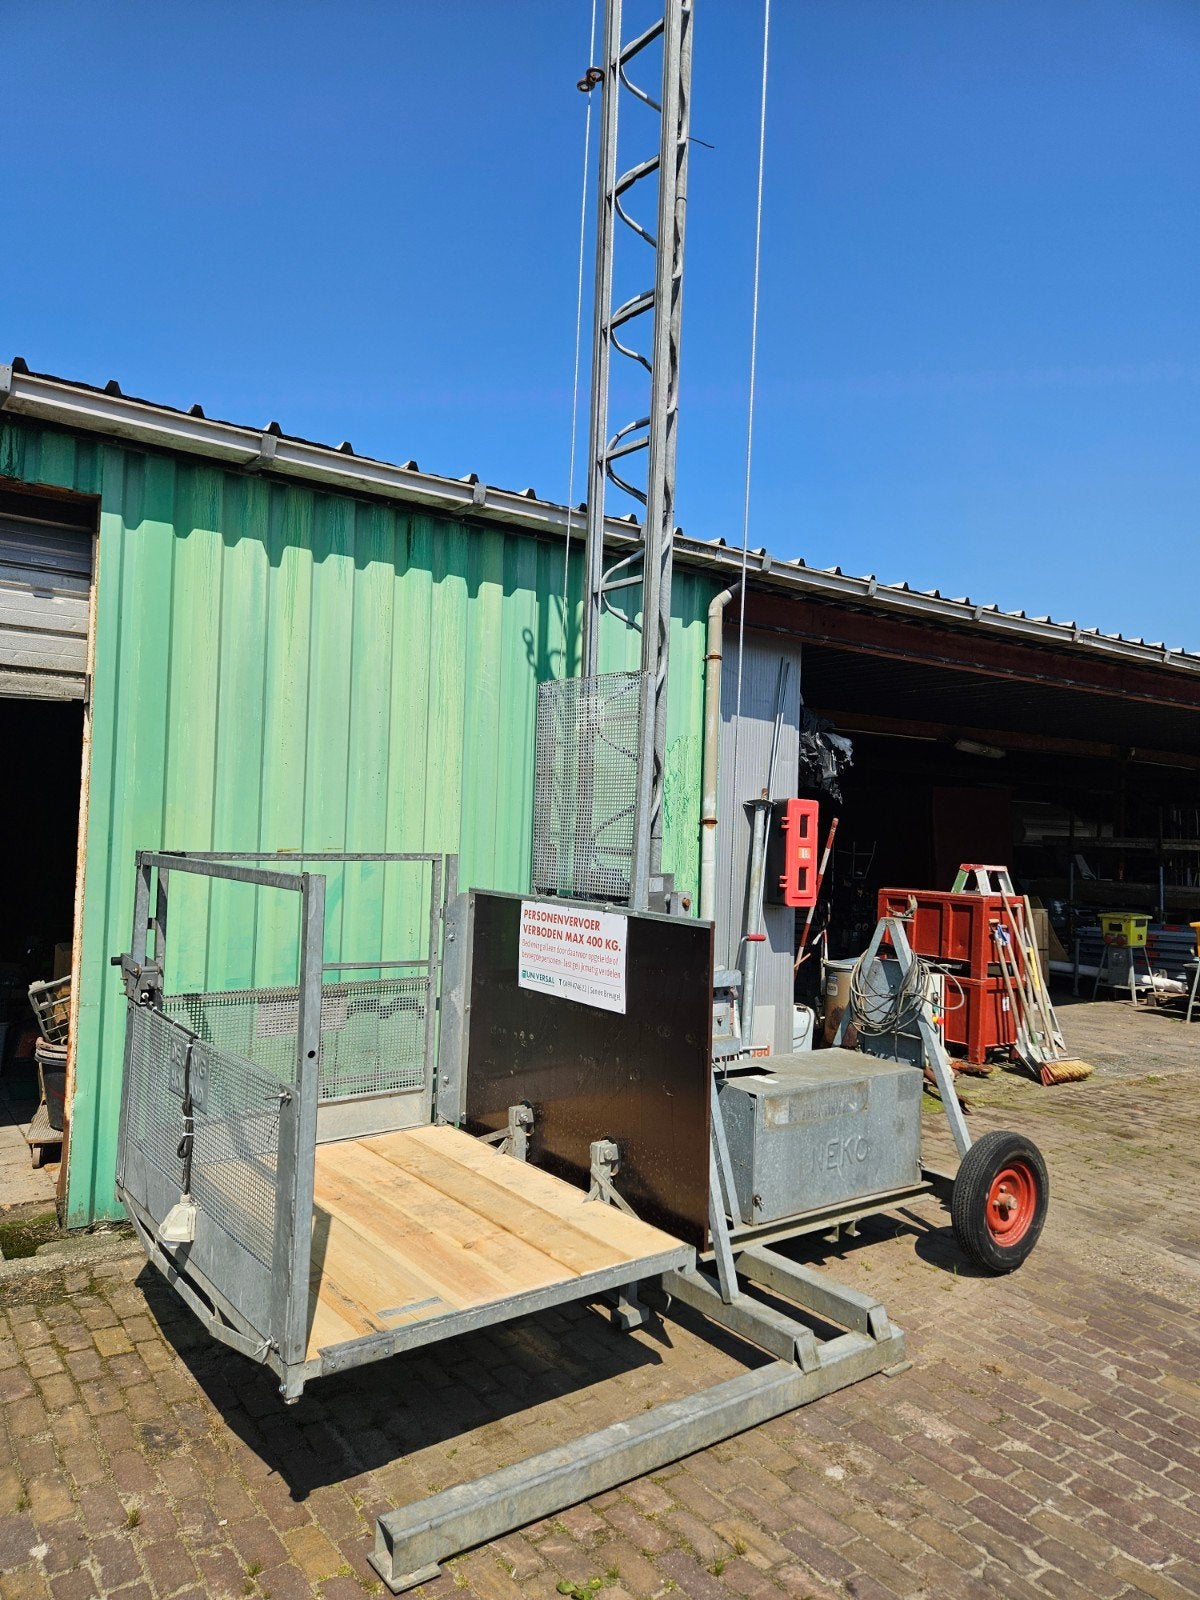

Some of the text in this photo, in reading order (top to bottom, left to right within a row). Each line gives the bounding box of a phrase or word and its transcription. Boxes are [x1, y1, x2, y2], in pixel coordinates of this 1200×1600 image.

[524, 909, 601, 931] PERSONENVERVOER
[523, 924, 621, 952] VERBODEN MAX 400 KG.
[526, 970, 555, 984] UNIVERSAL
